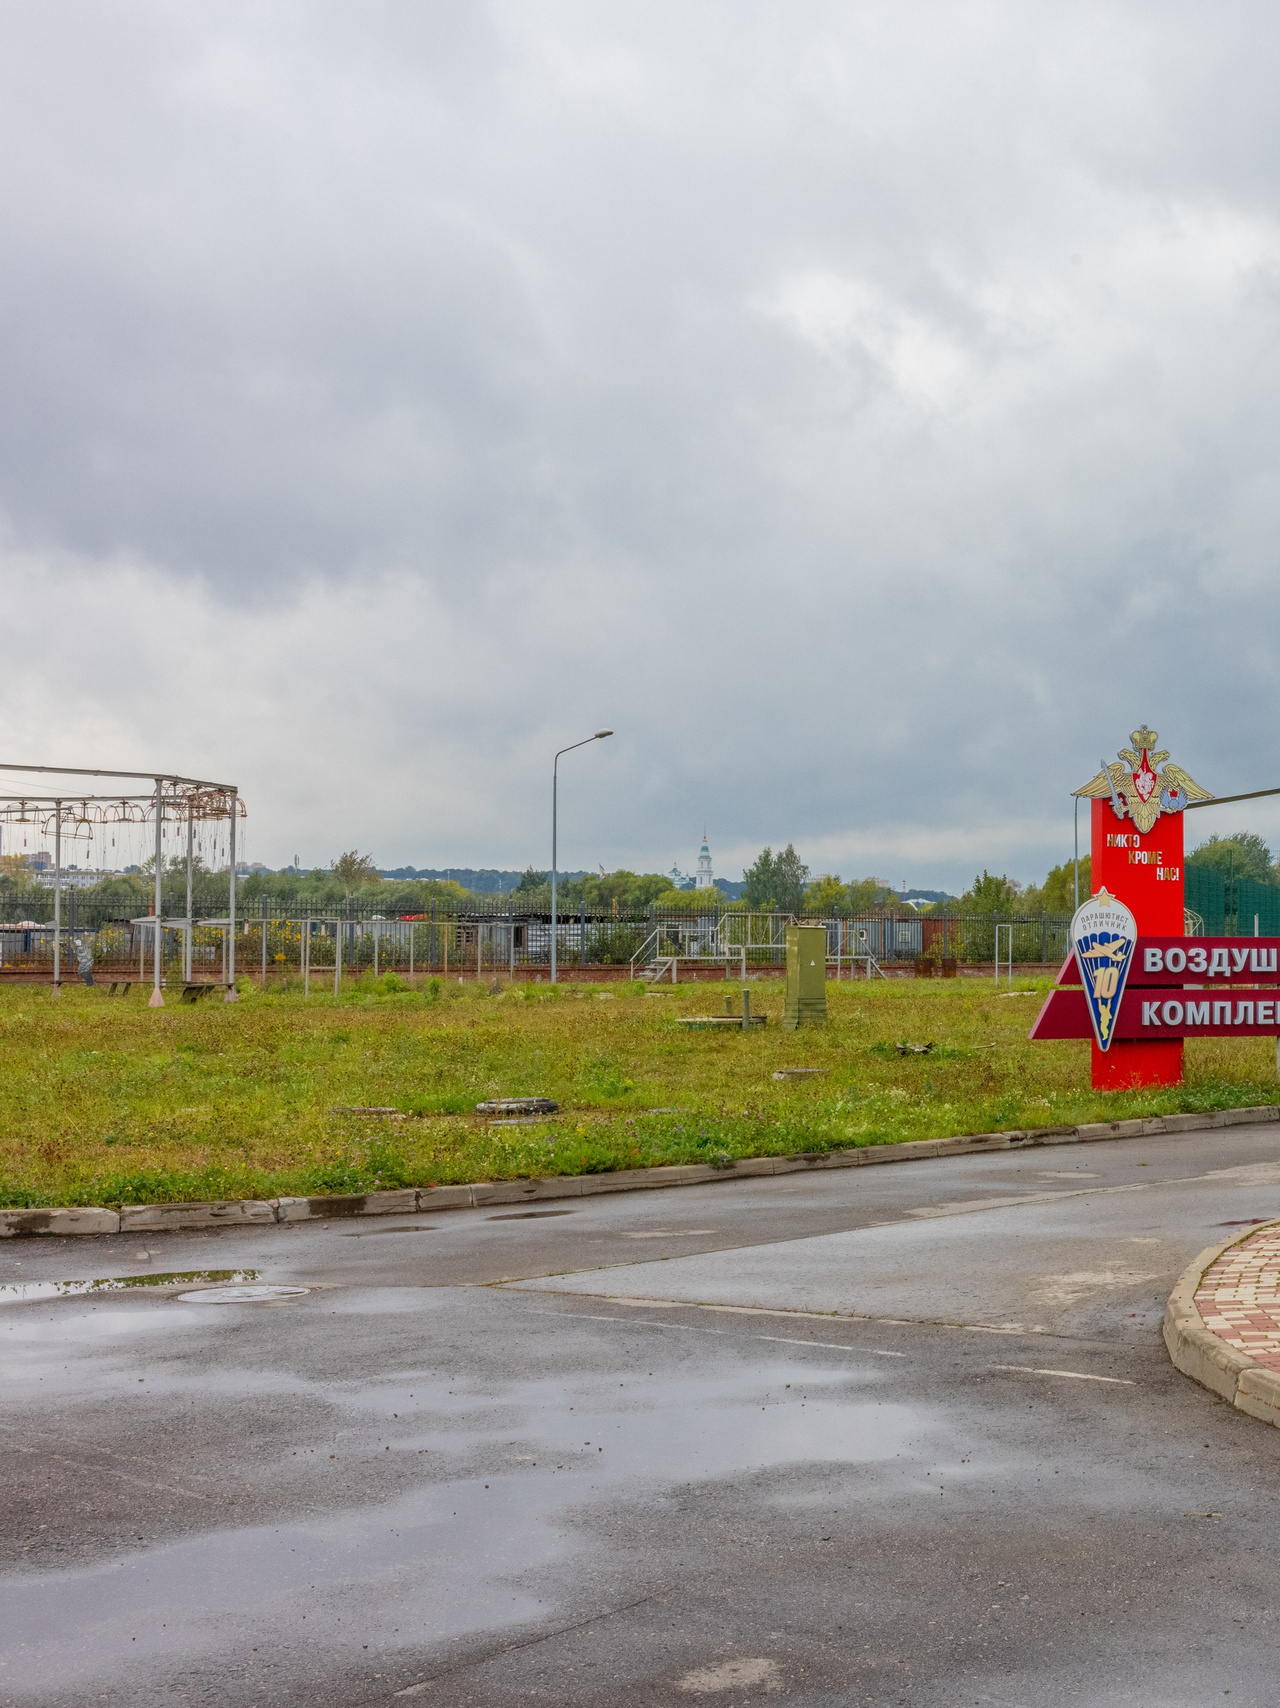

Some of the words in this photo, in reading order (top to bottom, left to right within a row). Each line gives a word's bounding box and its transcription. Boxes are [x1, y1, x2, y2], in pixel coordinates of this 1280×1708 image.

[1107, 834, 1140, 848] НИКТО
[1128, 851, 1162, 865] КРОМЕ
[1156, 867, 1179, 881] НАС!
[1080, 912, 1129, 924] ПАРАШЮТИСТ
[1082, 920, 1127, 931] ОТЛИЧНИК
[1093, 966, 1119, 999] 10
